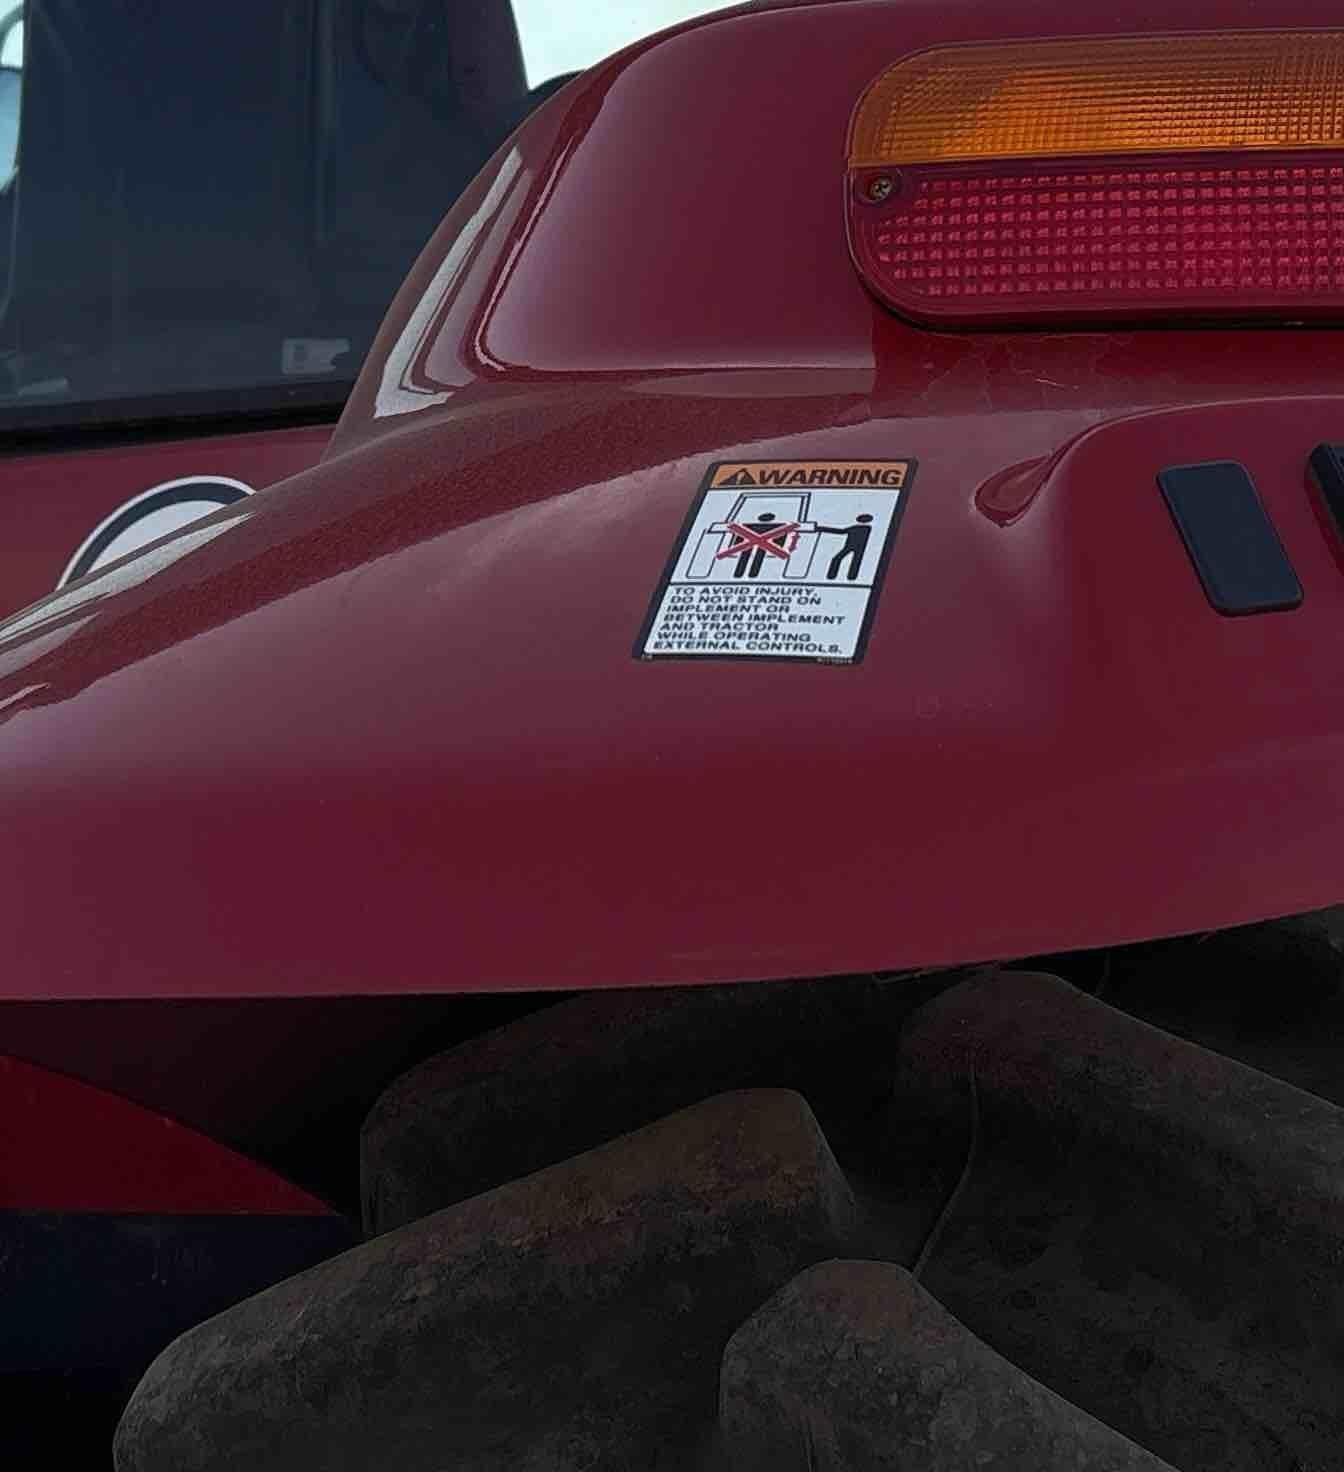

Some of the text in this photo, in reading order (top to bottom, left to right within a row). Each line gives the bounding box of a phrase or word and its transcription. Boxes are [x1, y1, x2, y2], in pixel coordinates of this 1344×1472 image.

[759, 468, 902, 485] WARNING
[674, 587, 695, 596] TO
[699, 587, 750, 596] AVOID
[670, 596, 822, 605] DO NOT STAND ON
[666, 604, 790, 613] IMPLEMENT OR
[663, 613, 845, 625] BETWEEN IMPLEMENT
[659, 622, 779, 631] AND TRACTOR
[657, 631, 812, 642] WHILE OPERATING
[654, 640, 843, 654] EXTERNAL CONTROLS.
